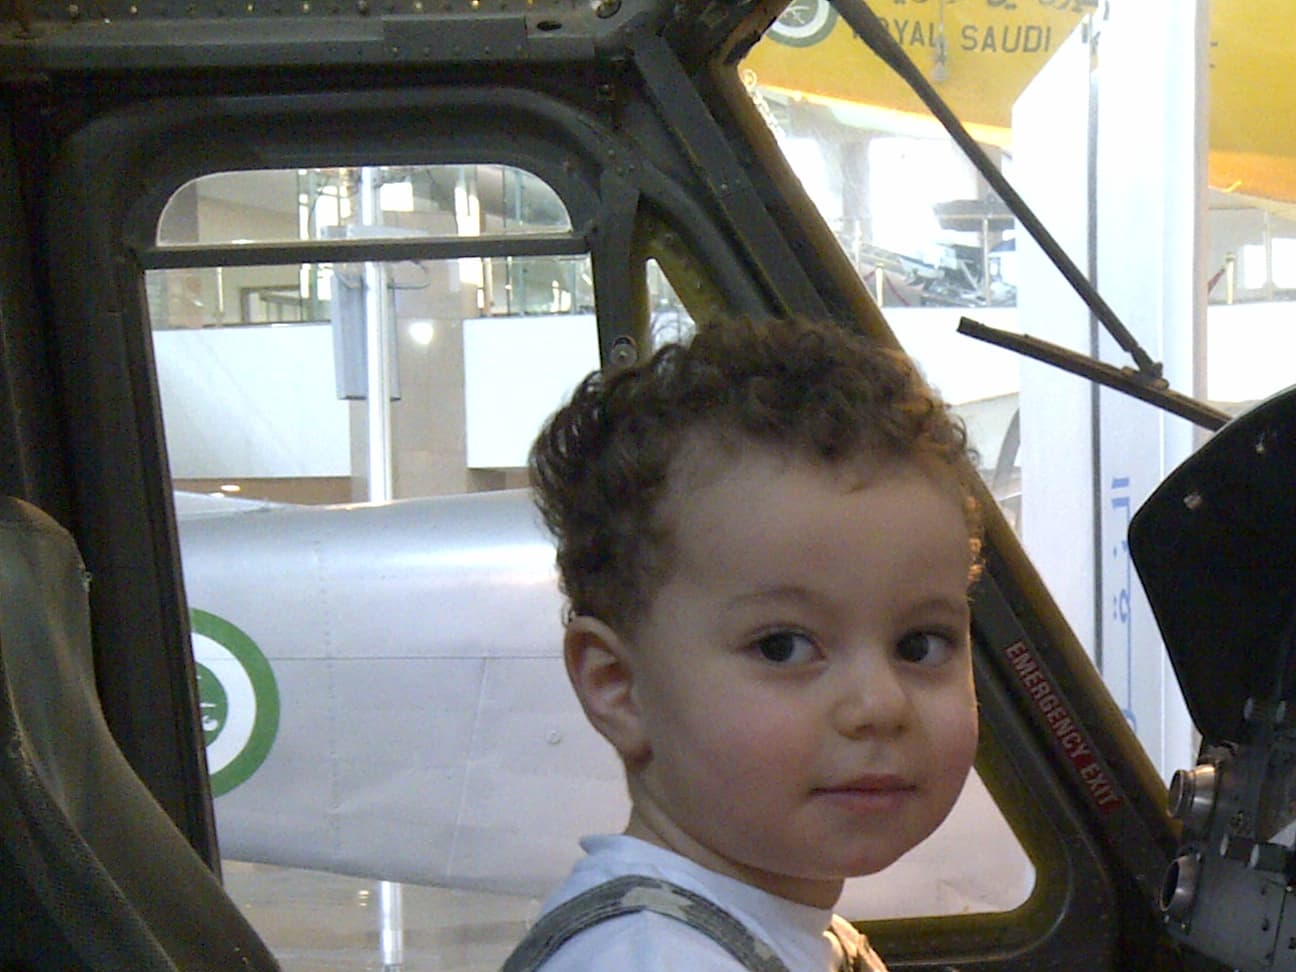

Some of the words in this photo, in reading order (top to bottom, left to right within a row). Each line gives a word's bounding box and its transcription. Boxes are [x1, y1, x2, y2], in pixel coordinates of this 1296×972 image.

[853, 20, 945, 48] YAL
[960, 24, 1052, 54] SAUDI
[1006, 640, 1089, 760] EMERGENCY
[1081, 763, 1116, 805] EXIT
